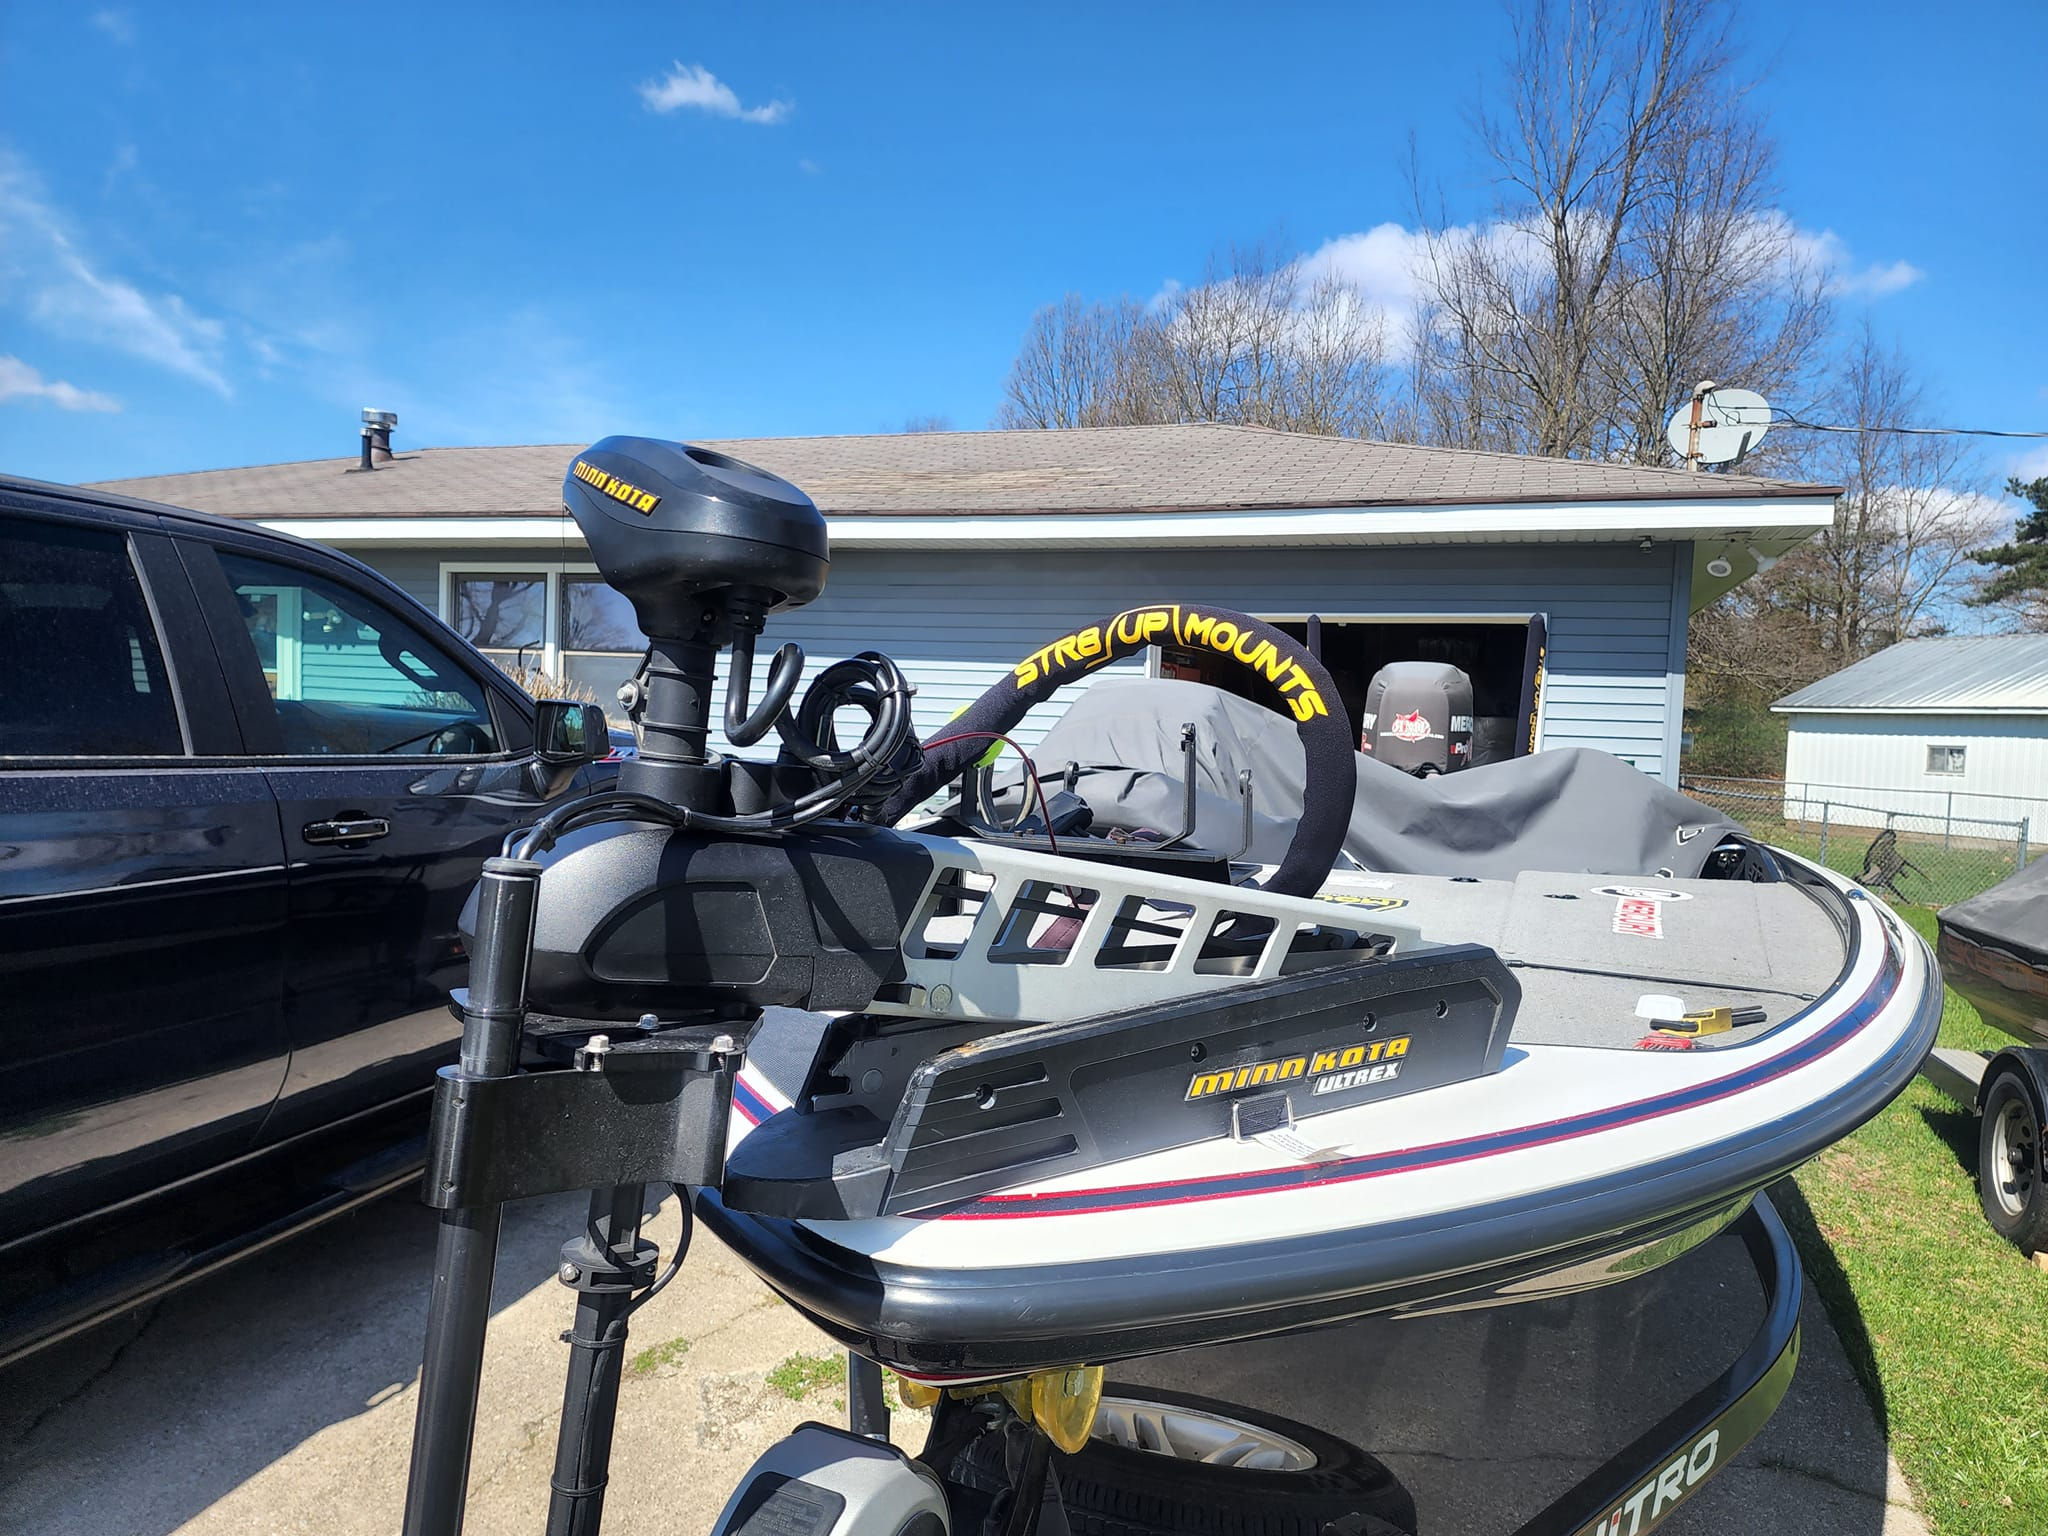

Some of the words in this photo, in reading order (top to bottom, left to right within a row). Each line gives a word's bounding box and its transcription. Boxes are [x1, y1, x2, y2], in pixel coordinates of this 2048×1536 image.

[603, 478, 657, 513] KOTA
[1014, 626, 1102, 690] STR8
[1117, 611, 1170, 644] UP
[1183, 612, 1329, 722] MOUNTS
[1617, 899, 1657, 937] MERCURY
[1312, 1036, 1412, 1074] KOTA
[1316, 1061, 1400, 1093] ULTREX
[1595, 1429, 1720, 1536] ITRO
